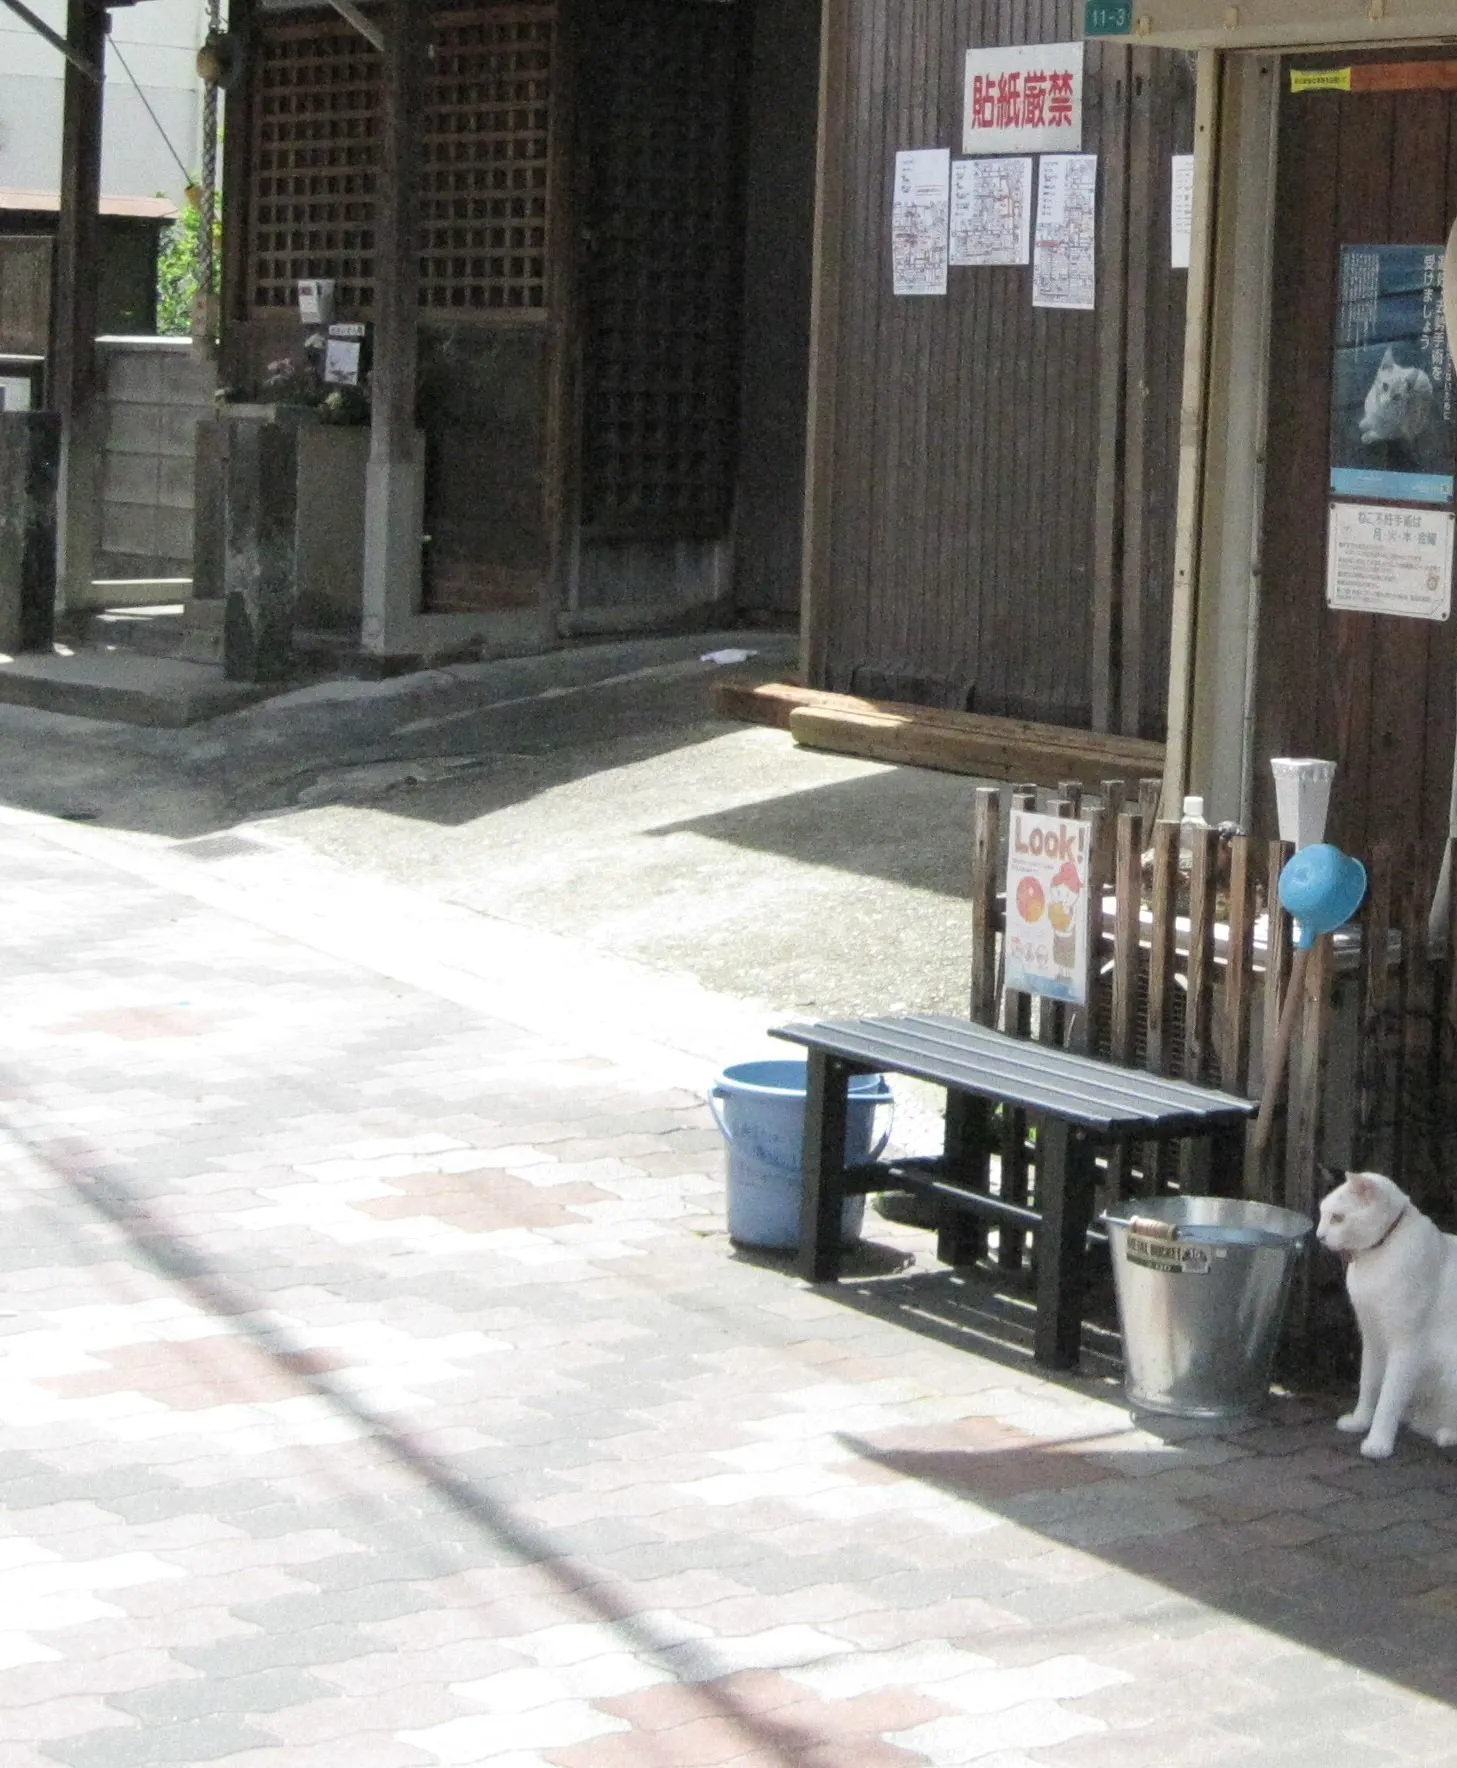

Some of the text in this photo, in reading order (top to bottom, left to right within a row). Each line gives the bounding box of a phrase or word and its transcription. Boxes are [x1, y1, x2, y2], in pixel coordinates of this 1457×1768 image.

[1093, 8, 1126, 28] 11-3
[971, 70, 1074, 129] 貼紙厳禁
[1420, 255, 1435, 350] 受けましょう
[1014, 816, 1086, 863] Look!
